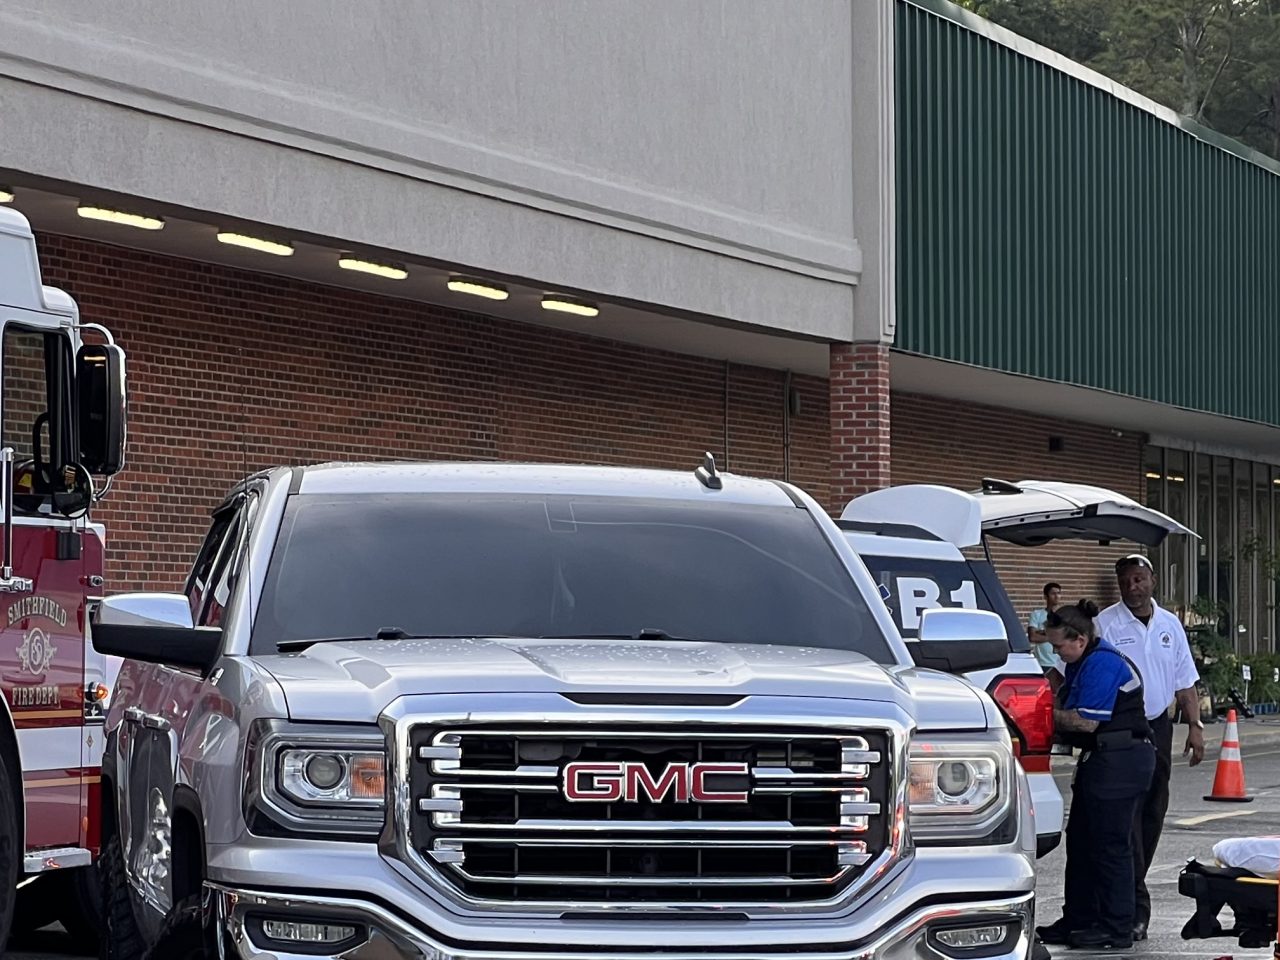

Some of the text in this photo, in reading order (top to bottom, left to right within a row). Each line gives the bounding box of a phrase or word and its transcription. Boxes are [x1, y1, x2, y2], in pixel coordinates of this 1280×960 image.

[8, 596, 67, 627] SMITHFIELD
[12, 686, 59, 706] FIRE DEPT
[562, 761, 748, 803] GMC
